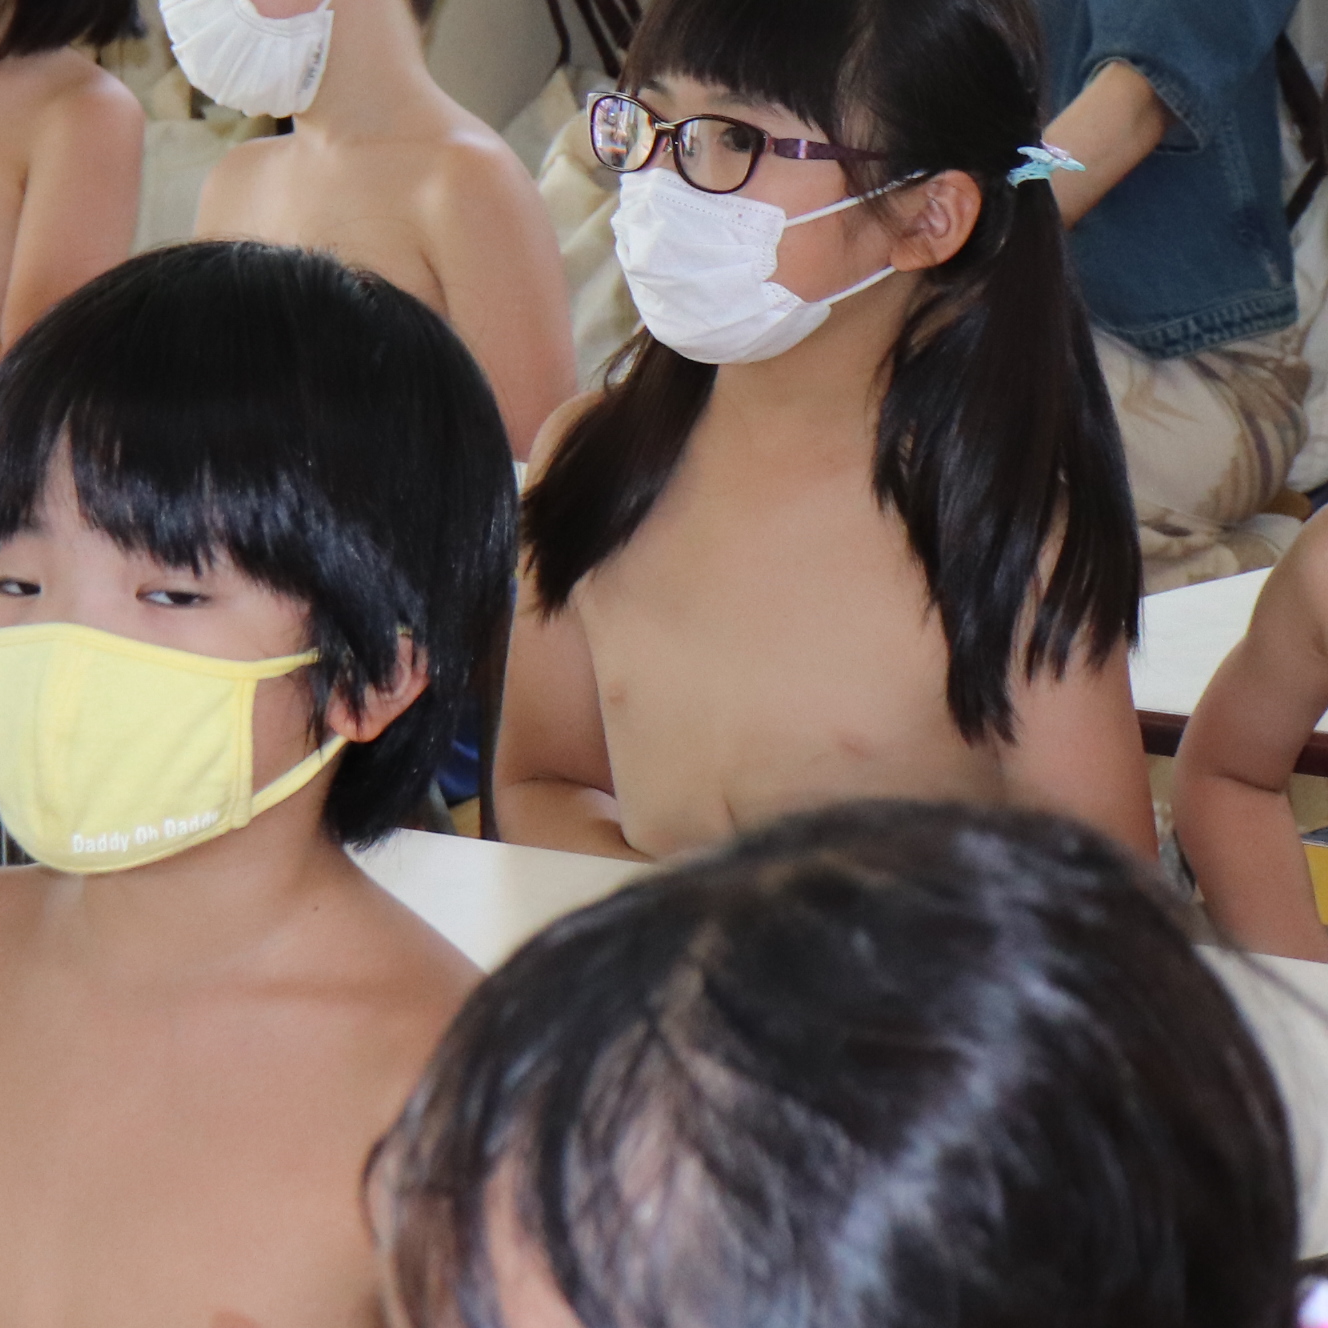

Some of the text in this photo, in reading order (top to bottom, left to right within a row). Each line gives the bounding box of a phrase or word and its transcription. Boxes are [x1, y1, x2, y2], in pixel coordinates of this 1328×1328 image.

[72, 811, 219, 853] Daddy Oh Daddy
